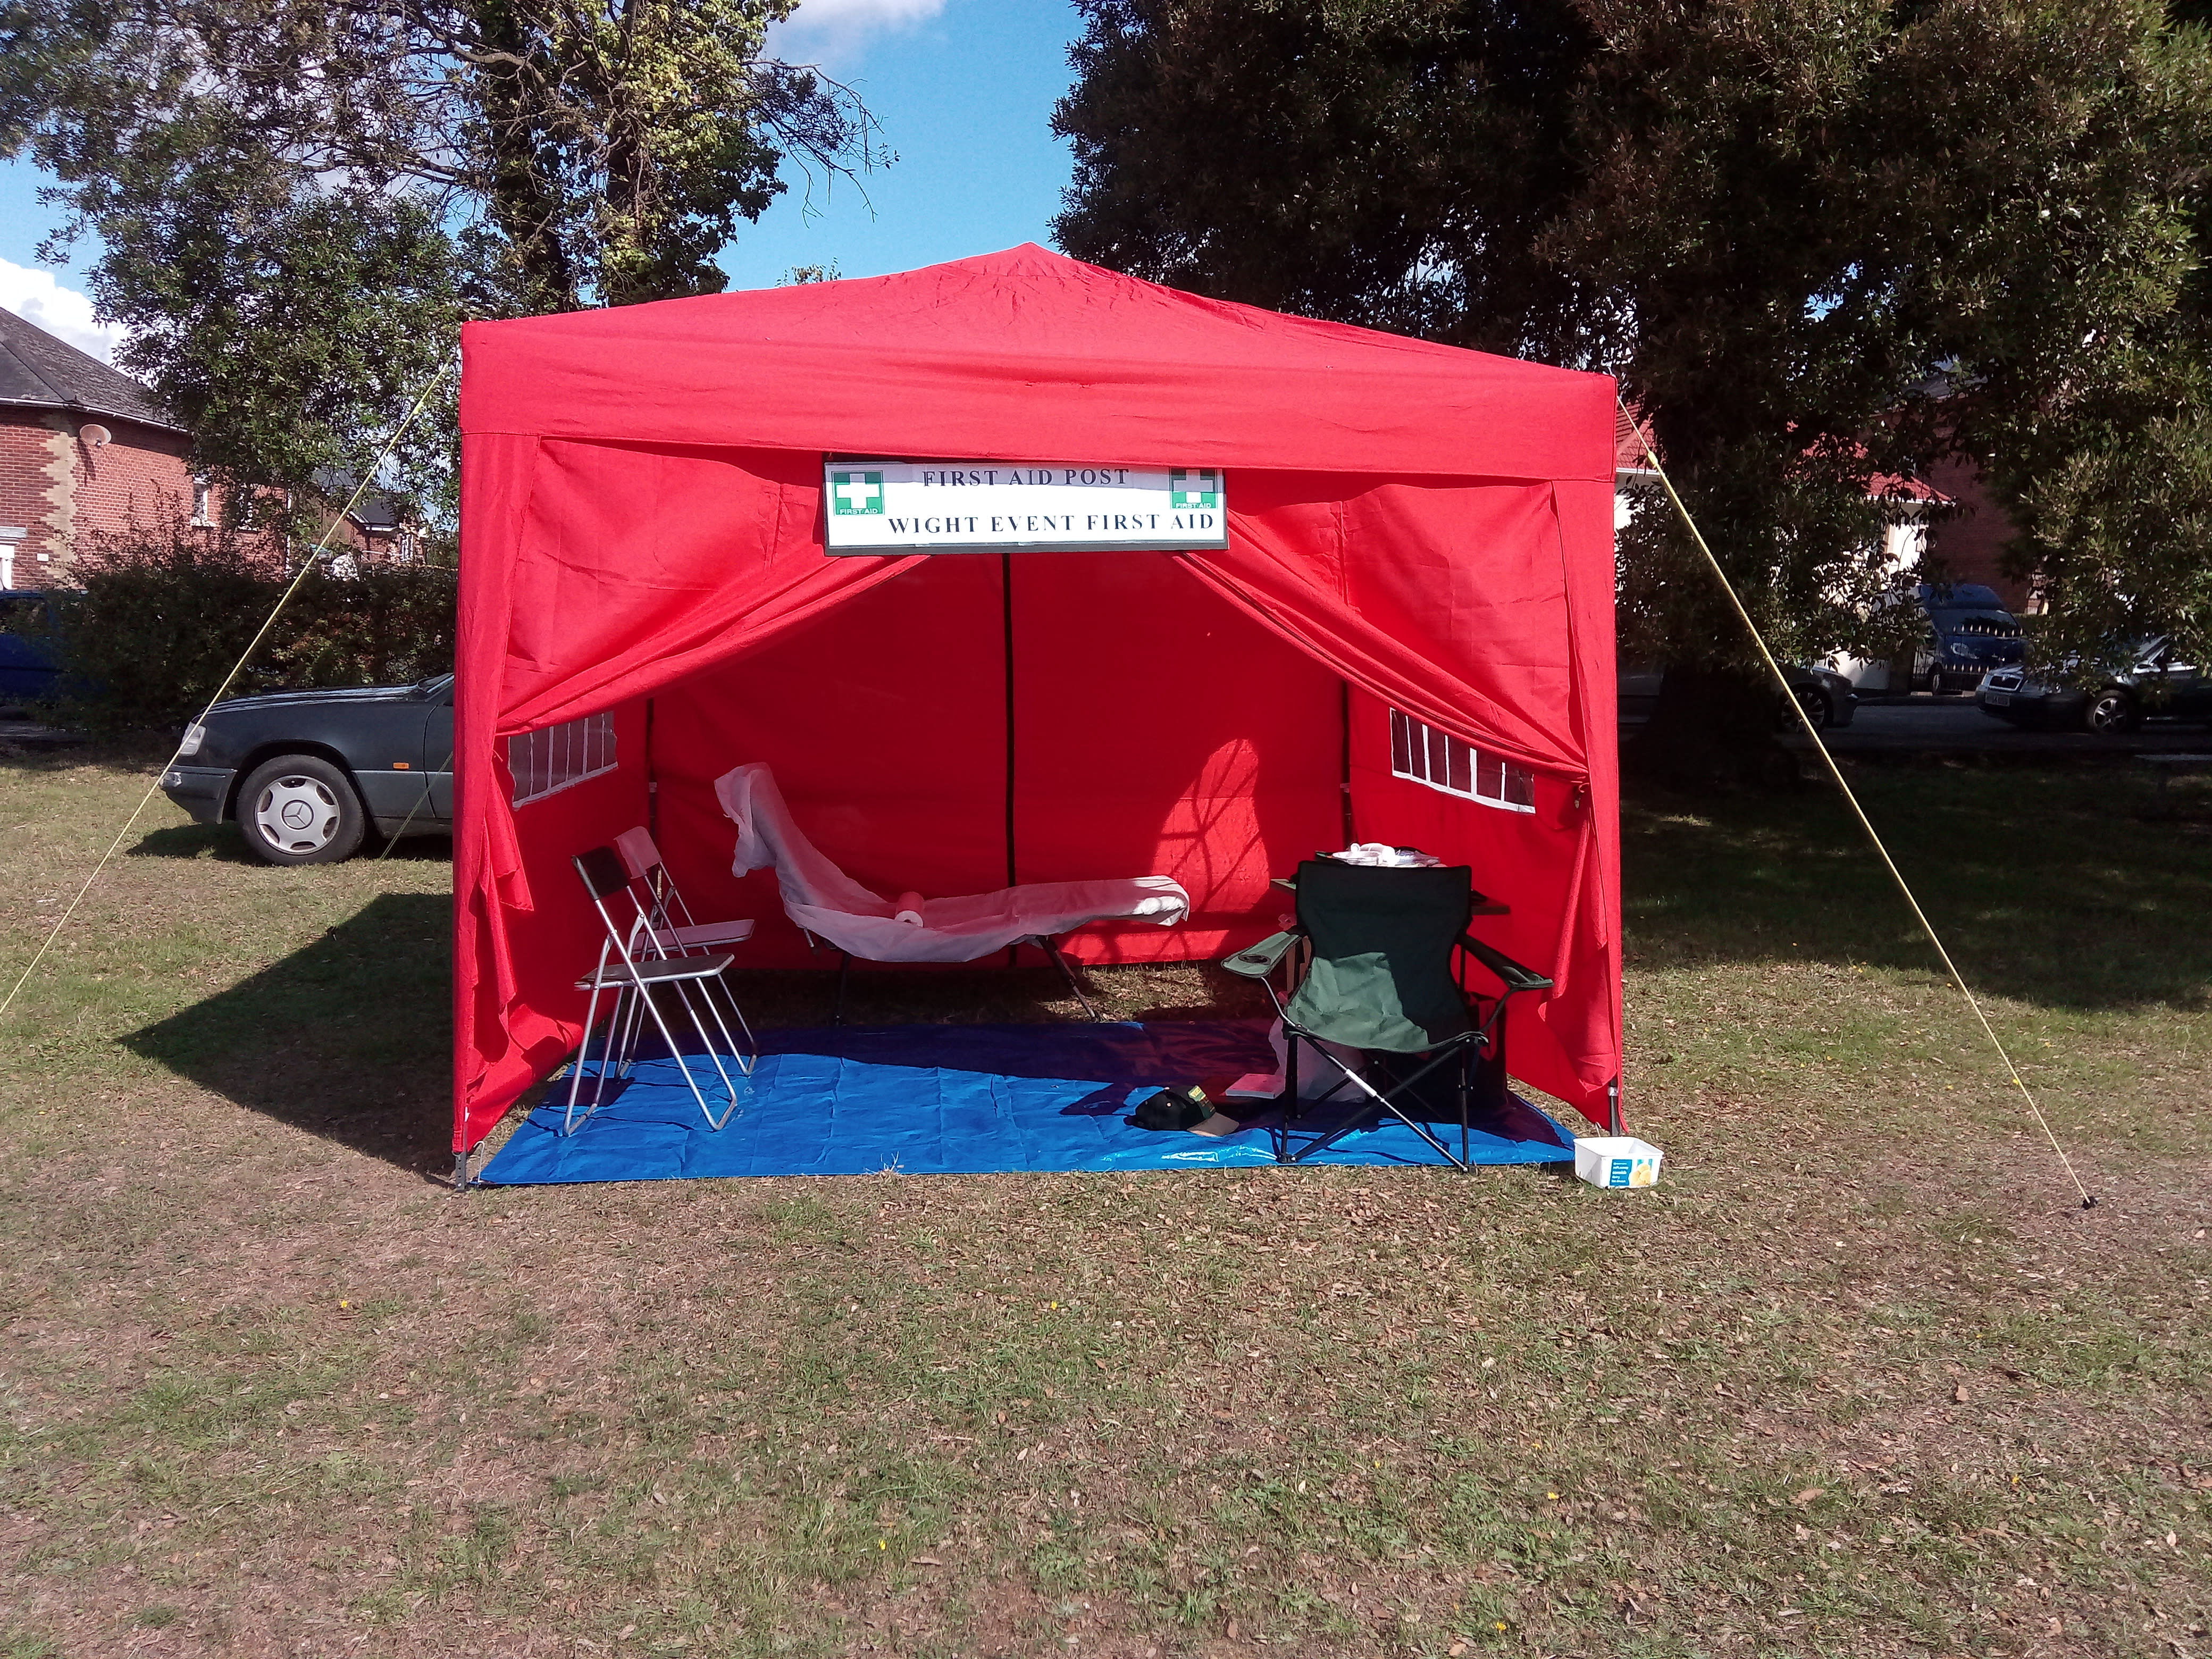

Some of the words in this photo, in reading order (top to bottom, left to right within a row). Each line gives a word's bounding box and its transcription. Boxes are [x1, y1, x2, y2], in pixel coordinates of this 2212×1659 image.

[922, 470, 998, 487] FIRST
[1009, 469, 1052, 485] AID
[1064, 468, 1129, 485] POST
[888, 517, 978, 533] WIGHT
[991, 515, 1075, 532] EVENT
[1087, 514, 1160, 530] FIRST
[1171, 514, 1213, 529] AID
